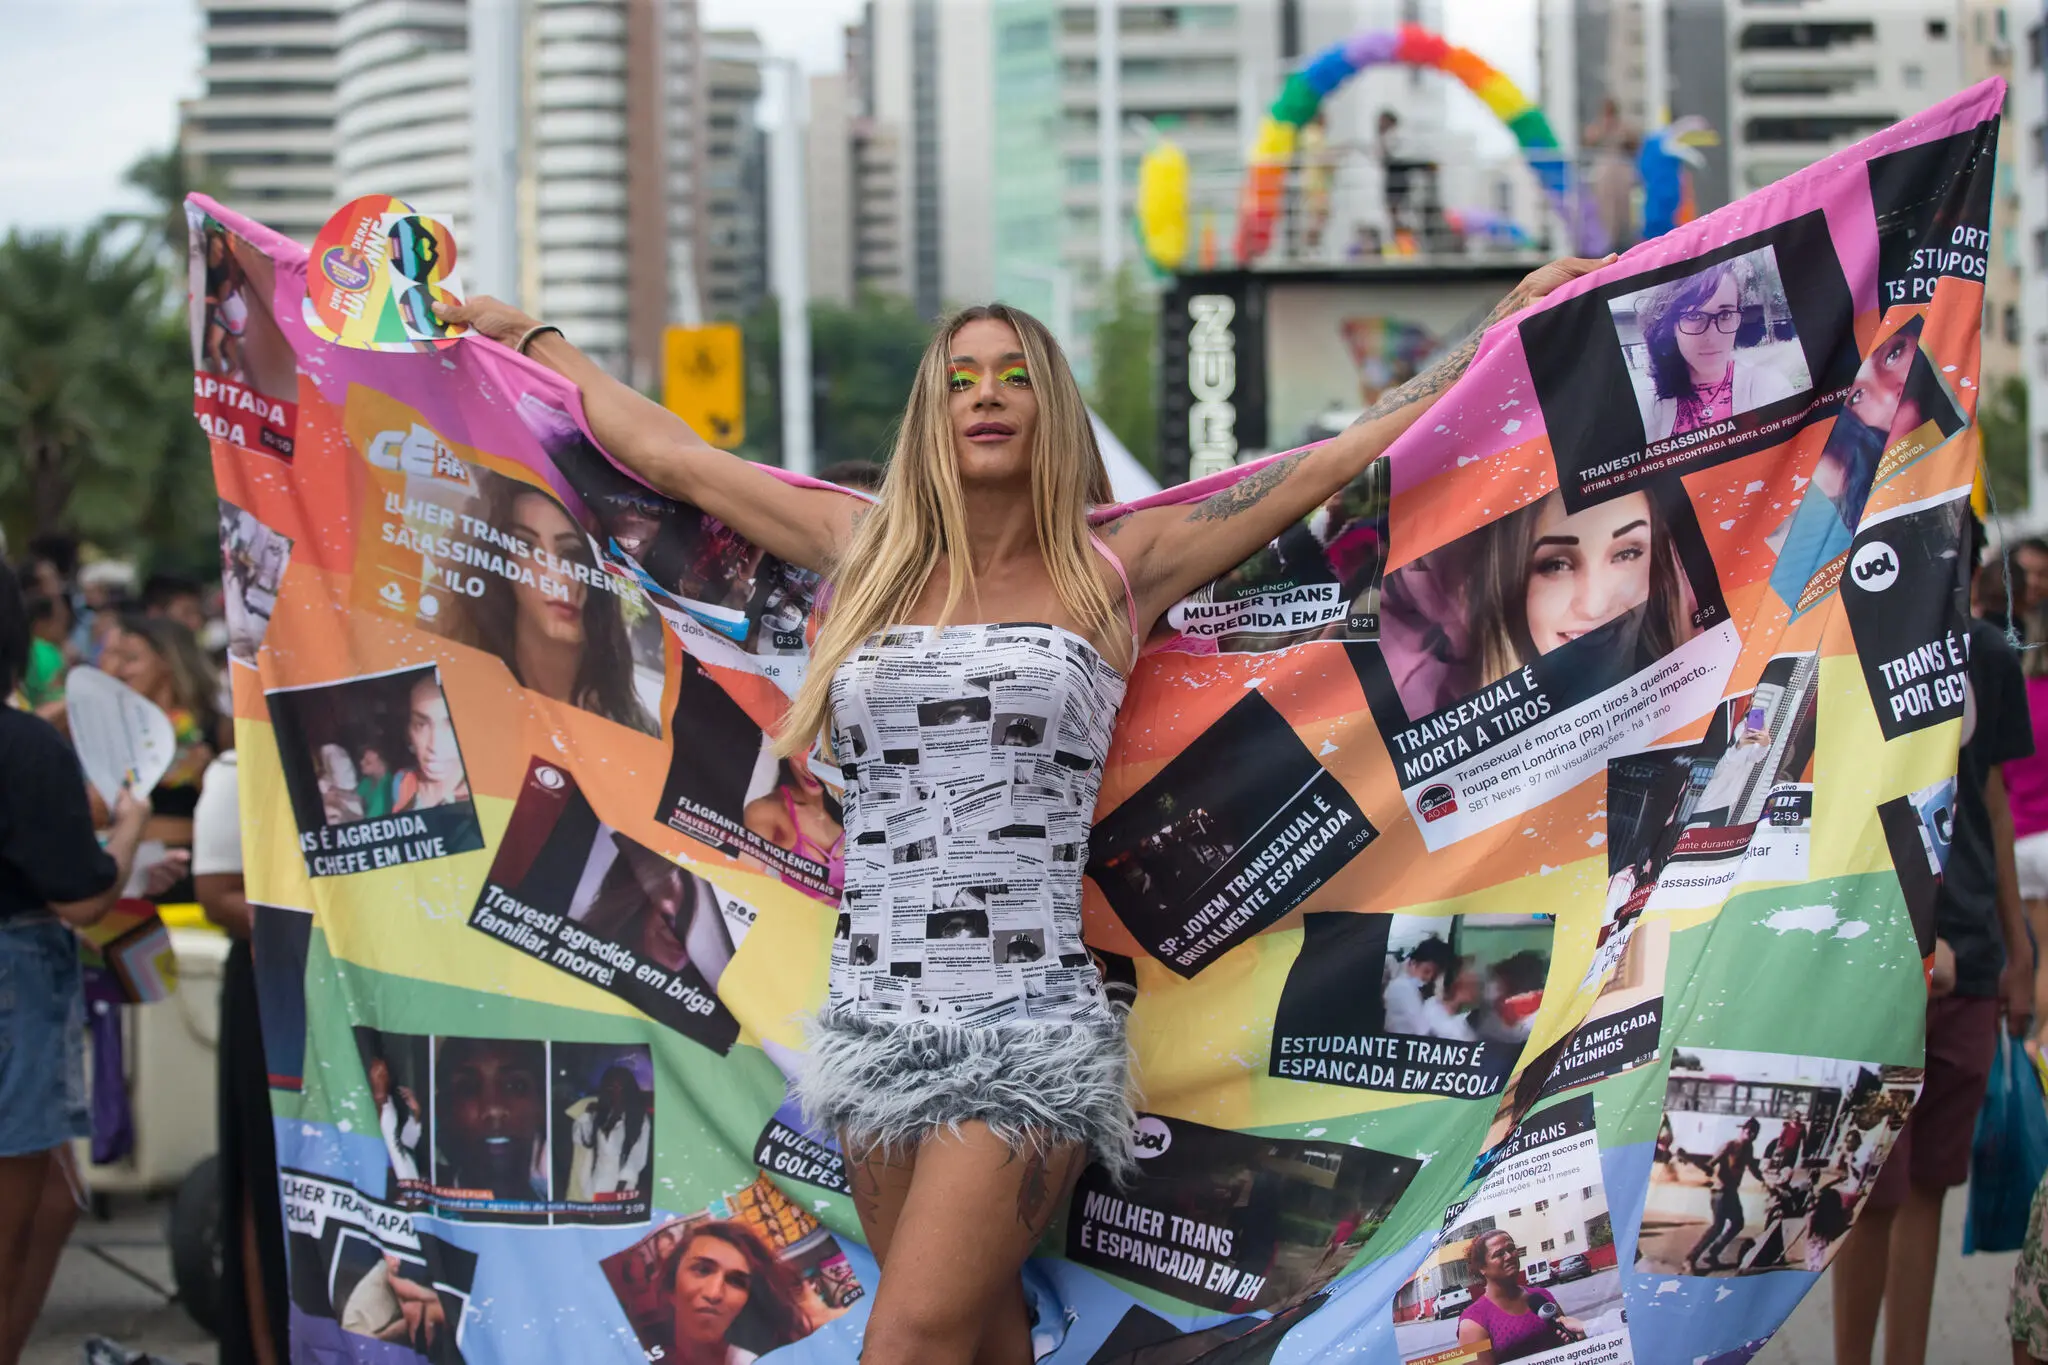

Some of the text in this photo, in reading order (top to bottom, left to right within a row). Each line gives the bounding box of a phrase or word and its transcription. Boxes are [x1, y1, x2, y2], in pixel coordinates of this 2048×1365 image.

[1951, 225, 1989, 251] ORT
[1912, 276, 1938, 299] PO
[194, 412, 246, 447] ADA
[1582, 477, 1613, 495] VÍTIMA
[1613, 473, 1626, 484] DE
[1627, 468, 1639, 479] 30
[1640, 460, 1666, 475] ANOS
[1666, 440, 1727, 467] ENCONTRADA
[1727, 429, 1760, 448] MORTA
[1759, 421, 1781, 436] COM
[1821, 393, 1835, 406] NO
[1579, 420, 1737, 482] TRAVESTI ASSASSINADA
[459, 513, 643, 608] TRANS CEARENSE
[539, 575, 569, 602] EM
[1237, 579, 1295, 598] VIOLÊNCIA
[1797, 585, 1824, 609] PRESO
[1800, 571, 1827, 598] ULHER
[1183, 587, 1333, 621] MULHER TRANS
[1185, 604, 1346, 636] AGREDIDA EM BH
[776, 634, 799, 646] 0:37
[1351, 618, 1375, 629] 9:21
[765, 665, 780, 676] de
[1878, 640, 1946, 690] TRANS
[1945, 630, 1963, 666] É
[1392, 663, 1540, 754] TRANSEXUAL É
[1889, 683, 1934, 722] POR
[1403, 693, 1552, 782] MORTA A TIROS
[1455, 746, 1523, 783] Transexual
[1524, 737, 1533, 750] é
[1535, 721, 1573, 747] morta
[1573, 709, 1603, 731] com
[1602, 692, 1630, 716] tiros
[1630, 683, 1639, 699] à
[1461, 774, 1499, 799] roupa
[1500, 766, 1522, 784] em
[1522, 739, 1578, 774] Londrina
[1578, 724, 1605, 750] (PR)
[1611, 691, 1659, 728] Primeiro
[1467, 796, 1492, 814] SBT
[1491, 783, 1523, 803] News
[1528, 774, 1543, 788] 97
[1545, 764, 1561, 781] mil
[1561, 731, 1626, 772] visualizações
[1631, 717, 1645, 733] há
[1650, 704, 1672, 721] ano
[322, 814, 428, 850] É AGREDIDA
[1773, 811, 1800, 822] 2:59
[673, 808, 718, 837] TRAVESTI
[726, 832, 784, 872] ASSASSINADA
[784, 866, 803, 883] POR
[802, 874, 836, 896] RIVAIS
[677, 796, 746, 838] FLAGRANTE
[746, 828, 763, 845] DE
[763, 836, 824, 878] VIOLÊNCIA
[1347, 828, 1371, 851] 2:08
[1701, 838, 1735, 849] durante
[313, 837, 447, 876] CHEFE EM LIVE
[1158, 933, 1186, 957] SP:
[1181, 897, 1231, 941] JOVEM
[1224, 809, 1320, 898] TRANSEXUAL
[1312, 793, 1332, 817] É
[1175, 890, 1271, 968] BRUTALMENTE
[1265, 808, 1353, 895] ESPANCADA
[1661, 870, 1736, 889] assassinada
[472, 907, 616, 987] familiar, morre!
[484, 885, 717, 1017] Travesti agredida em briga
[1573, 1011, 1657, 1052] É AMEAÇADA
[1280, 1036, 1485, 1068] ESTUDANTE TRANS É
[1564, 1038, 1624, 1071] VIZINHOS
[1278, 1058, 1500, 1096] ESPANCADA EM ESCOLA
[768, 1123, 844, 1172] MULHER
[1523, 1121, 1567, 1149] TRANS
[758, 1145, 772, 1164] A
[774, 1151, 841, 1189] GOLPES
[1507, 1160, 1530, 1171] trans
[1530, 1152, 1550, 1164] com
[1551, 1143, 1578, 1158] socos
[1579, 1138, 1594, 1149] em
[1506, 1161, 1552, 1186] (10/06/22)
[285, 1204, 317, 1226] RUA
[1083, 1190, 1235, 1257] MULHER TRANS
[1080, 1220, 1267, 1302] É ESPANCADA EM BH
[1565, 1337, 1624, 1362] agredida por
